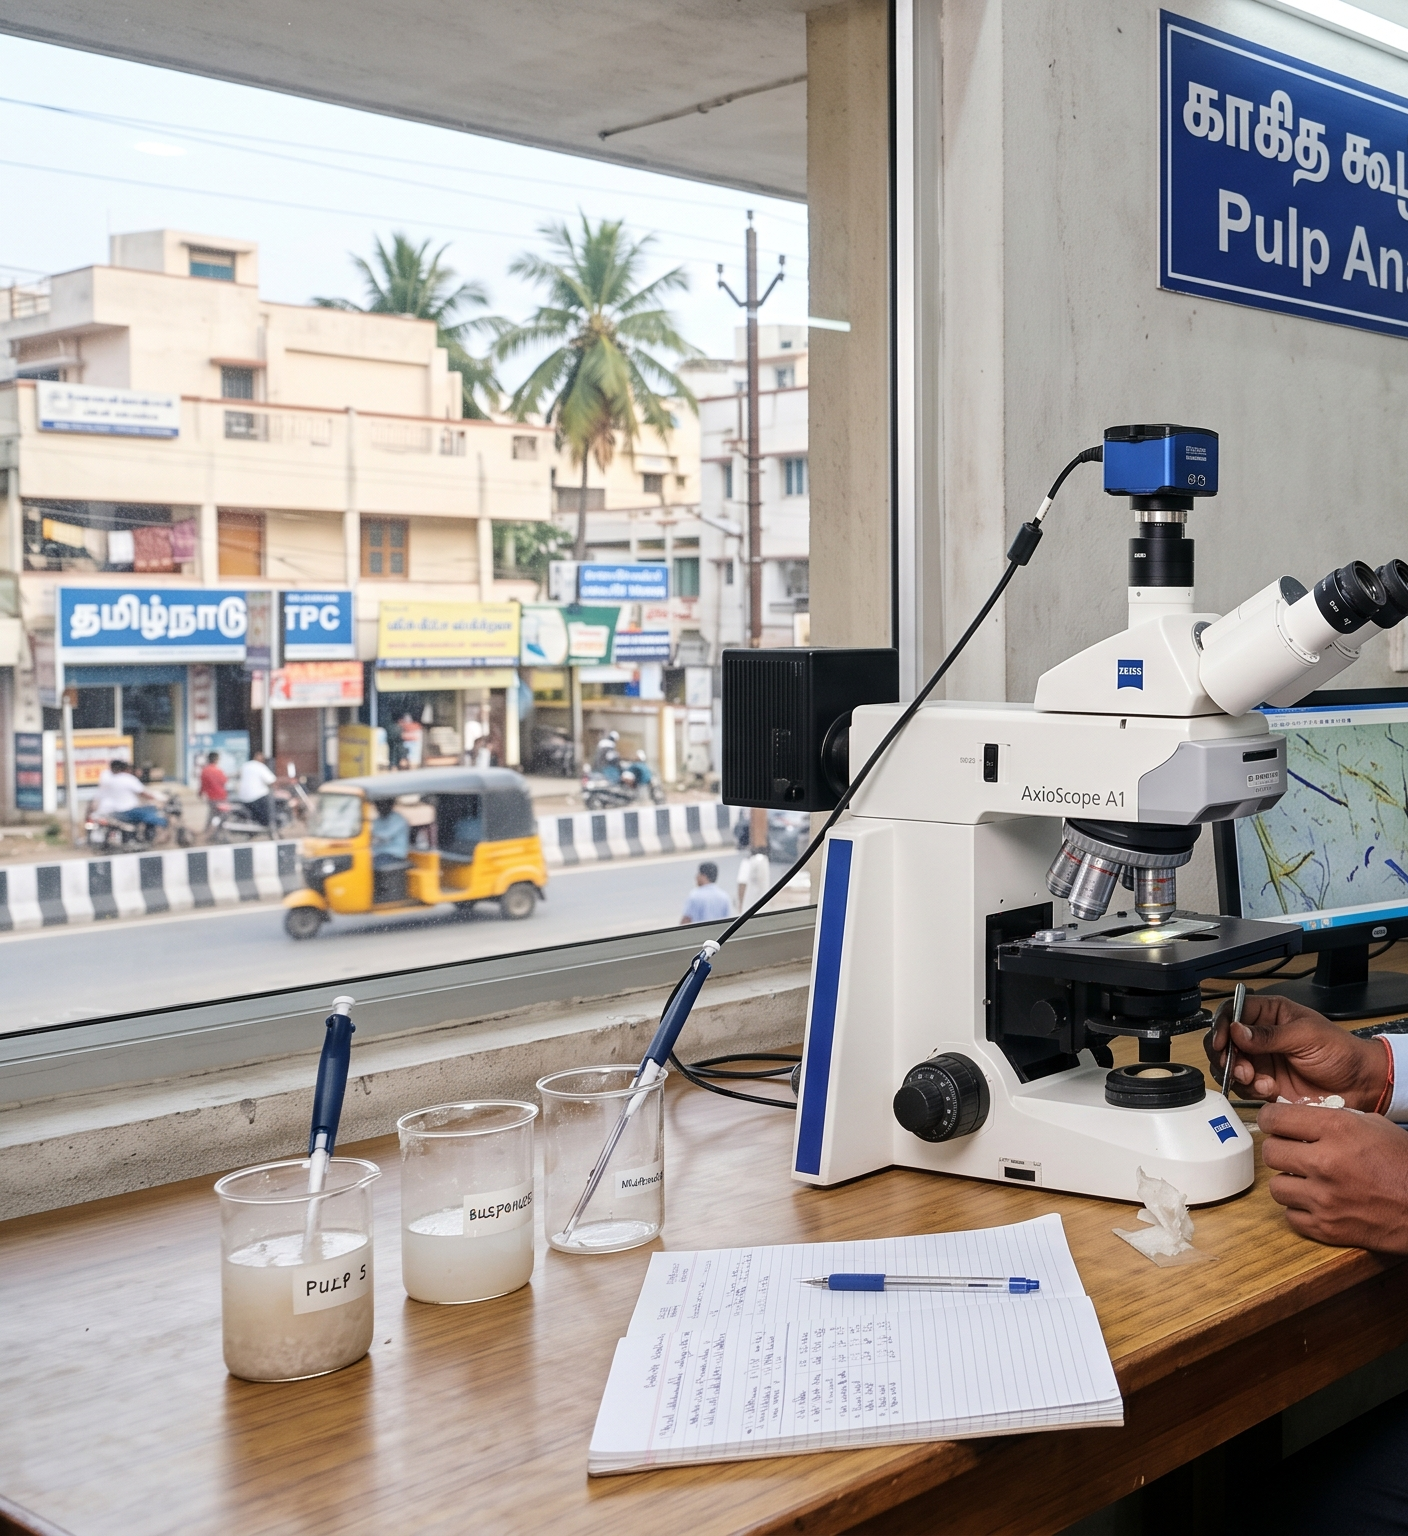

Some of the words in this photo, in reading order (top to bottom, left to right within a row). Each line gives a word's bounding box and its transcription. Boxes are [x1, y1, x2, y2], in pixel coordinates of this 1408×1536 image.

[1182, 80, 1330, 188] காகித
[1218, 188, 1330, 287] Pulp
[70, 593, 247, 640] தமிழ்நாடு
[284, 604, 340, 631] TPC
[1118, 667, 1142, 675] ZEISS
[1021, 785, 1101, 809] AxioScope
[1105, 790, 1124, 808] A1
[306, 1272, 351, 1297] PULP
